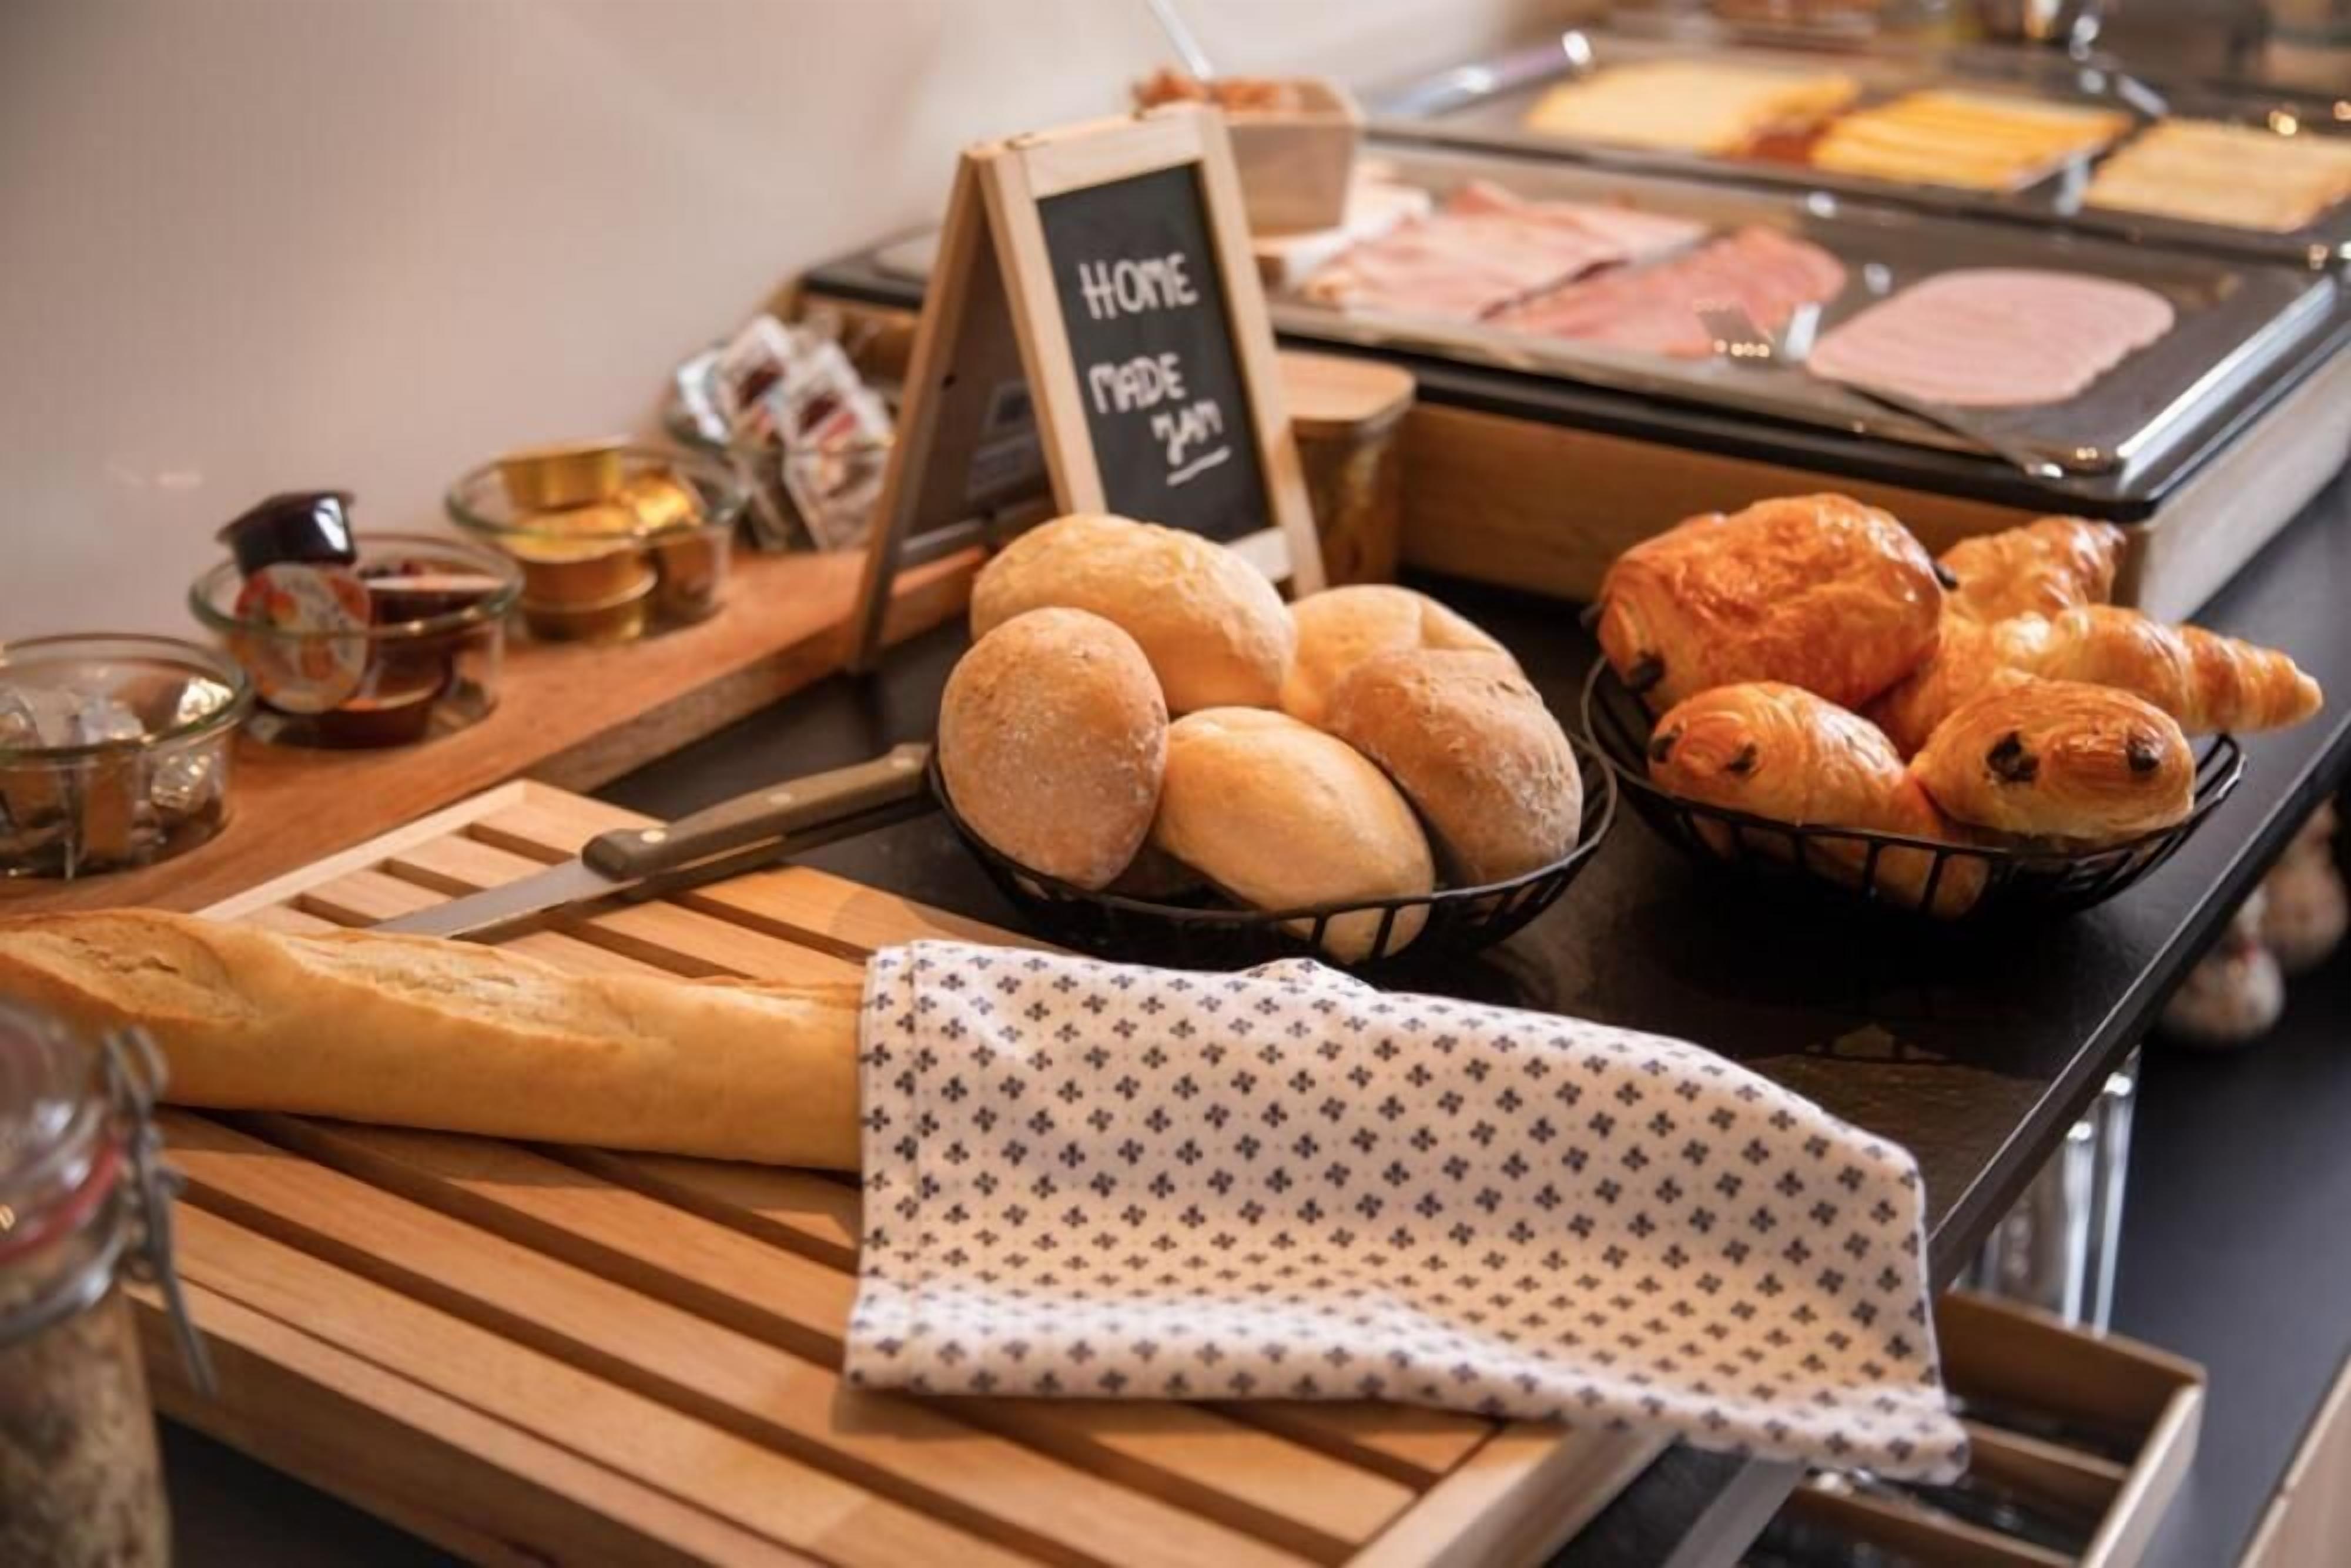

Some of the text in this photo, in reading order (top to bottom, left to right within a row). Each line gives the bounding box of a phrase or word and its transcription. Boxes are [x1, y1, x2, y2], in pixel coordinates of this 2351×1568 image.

[1079, 253, 1198, 319] HOME
[1089, 353, 1186, 413] MADE
[1151, 400, 1223, 465] JAM
